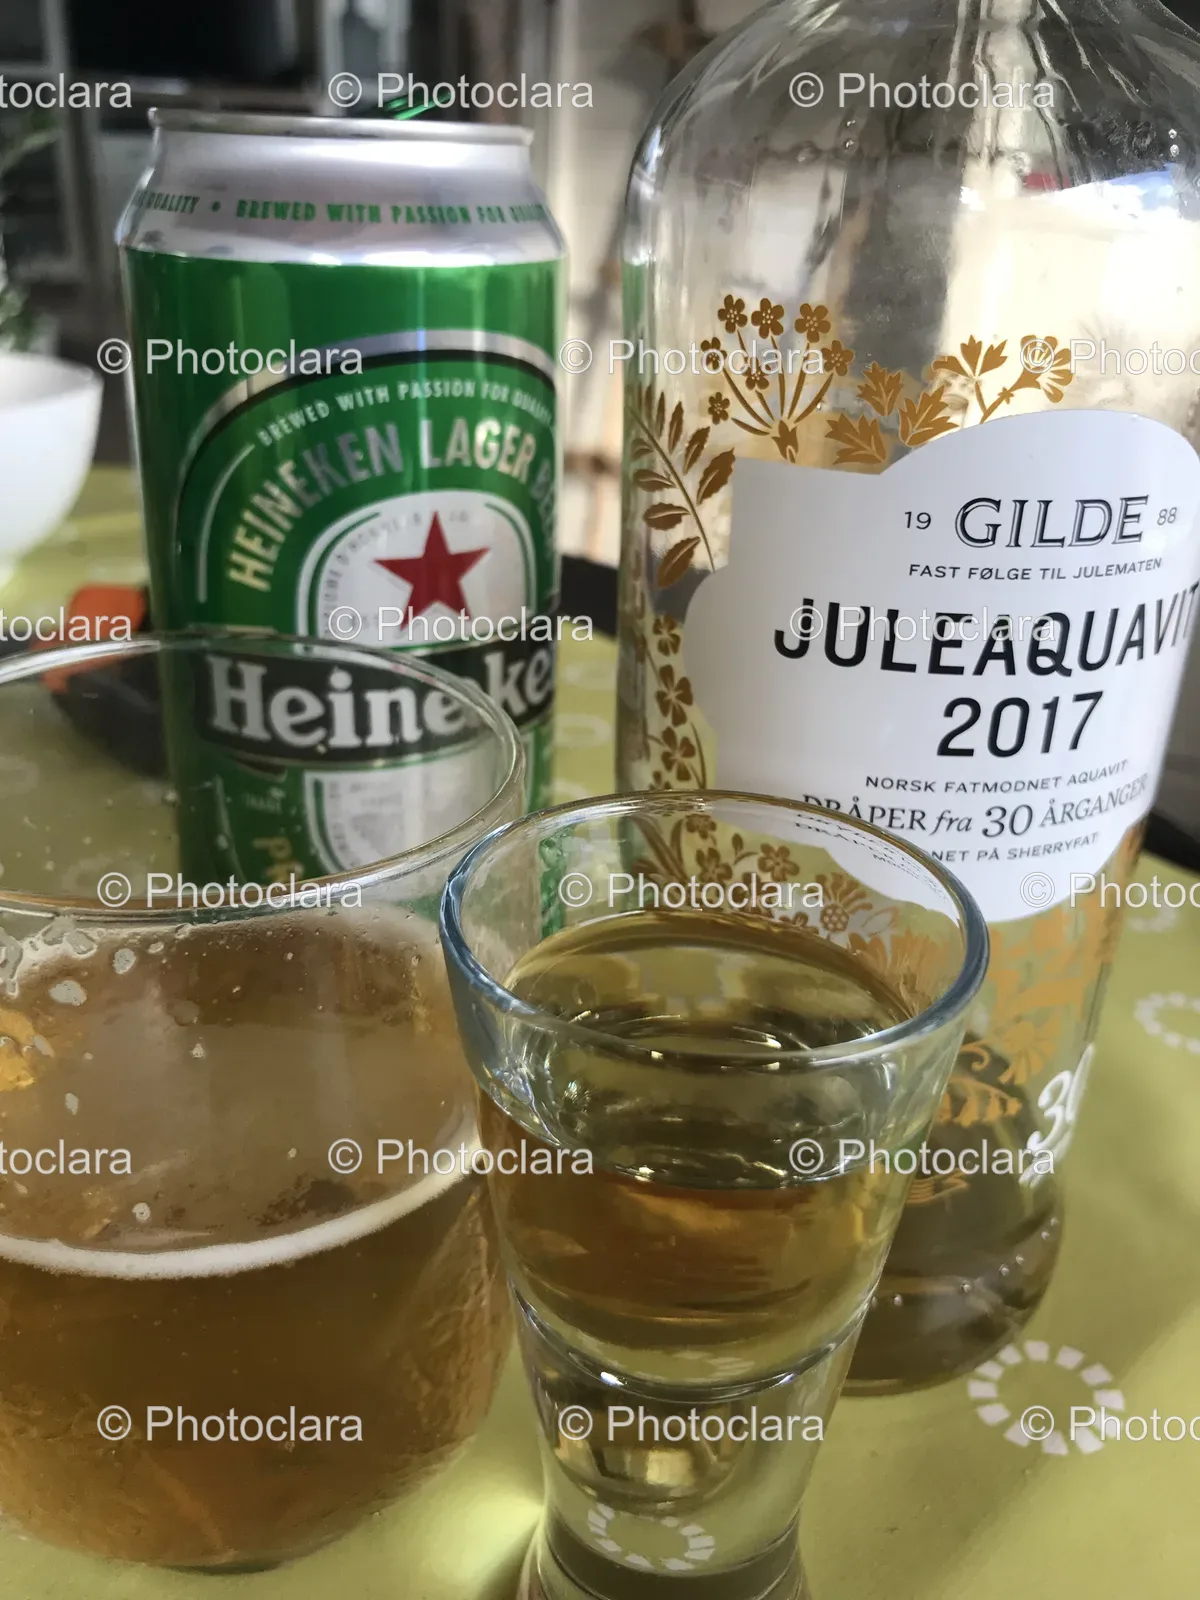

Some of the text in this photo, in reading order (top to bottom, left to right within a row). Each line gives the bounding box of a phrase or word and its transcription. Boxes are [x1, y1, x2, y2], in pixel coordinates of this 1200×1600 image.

[236, 200, 316, 221] BREWED
[327, 204, 381, 223] WITH
[391, 204, 471, 224] PASSION
[258, 399, 330, 446] BREWED
[335, 385, 390, 411] WITH
[397, 379, 477, 400] PASSION
[481, 381, 509, 402] FOR
[227, 421, 404, 592] HEINEKEN
[419, 415, 536, 484] LAGER
[904, 494, 1178, 548] 19 GILDE 88
[909, 557, 1162, 581] FAST FØLGE TIL JULEMATEN
[774, 578, 1200, 677] JULEAQUAVIT
[936, 690, 1104, 758] 2017
[865, 759, 1127, 794] NORSK FATMODNET AQUAVIT
[929, 809, 973, 836] fra
[981, 804, 1034, 838] 30
[1039, 772, 1149, 829] ÅRGANGER
[977, 845, 1000, 862] PÅ
[1006, 832, 1100, 862] SHERRYFAT
